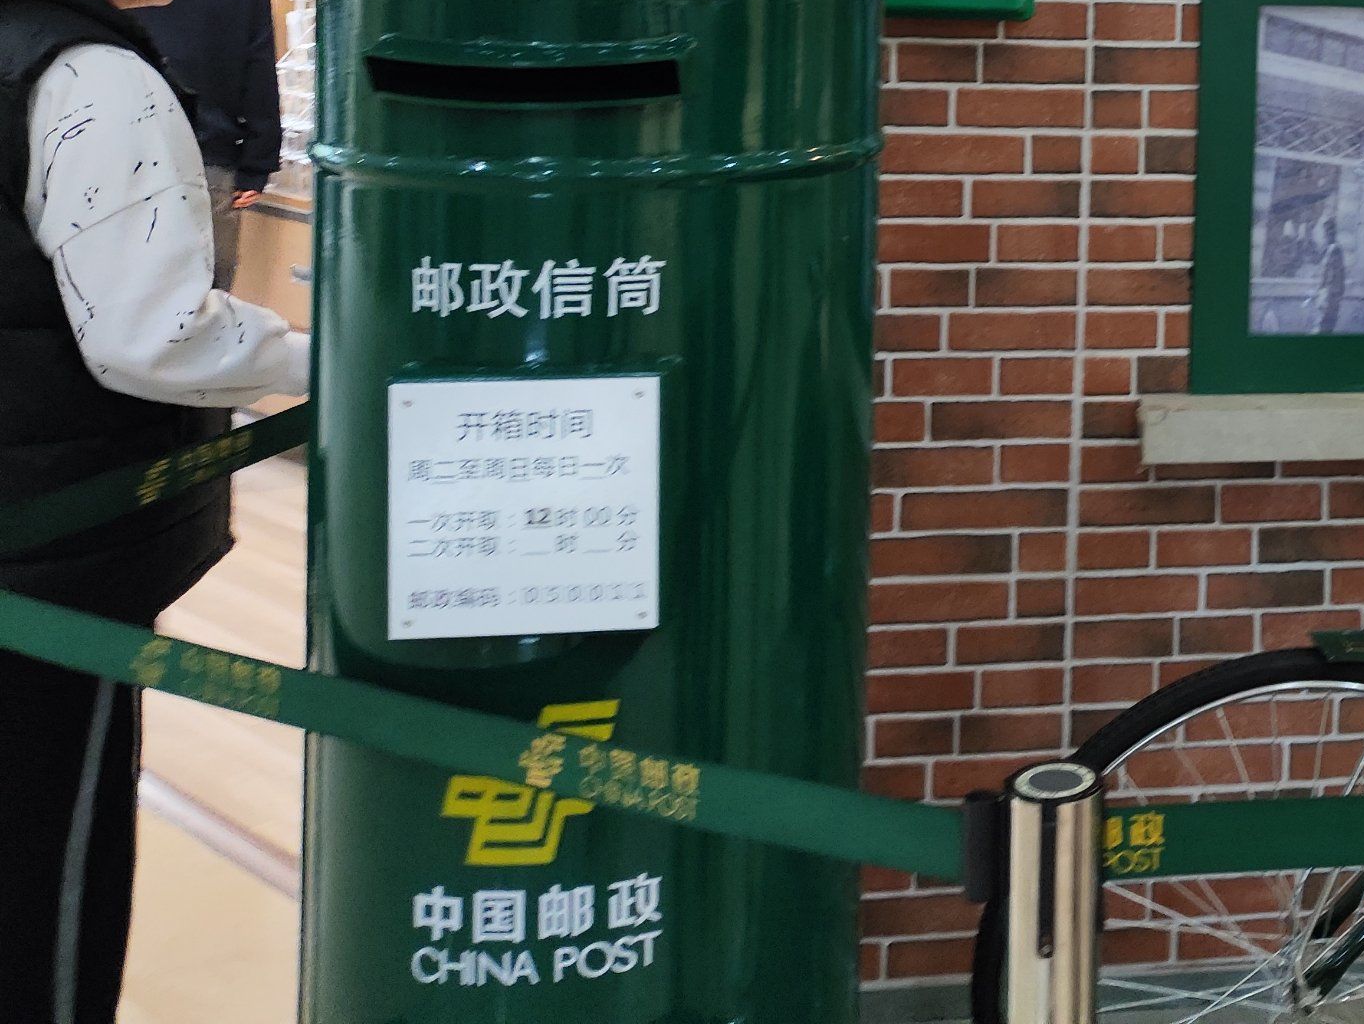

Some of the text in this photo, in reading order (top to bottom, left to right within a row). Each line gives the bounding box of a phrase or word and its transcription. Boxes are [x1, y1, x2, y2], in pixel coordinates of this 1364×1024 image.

[410, 255, 668, 320] 邮政信筒
[456, 408, 593, 442] 开箱时间
[411, 872, 664, 945] 中国邮政
[410, 929, 664, 988] CHINA POST
